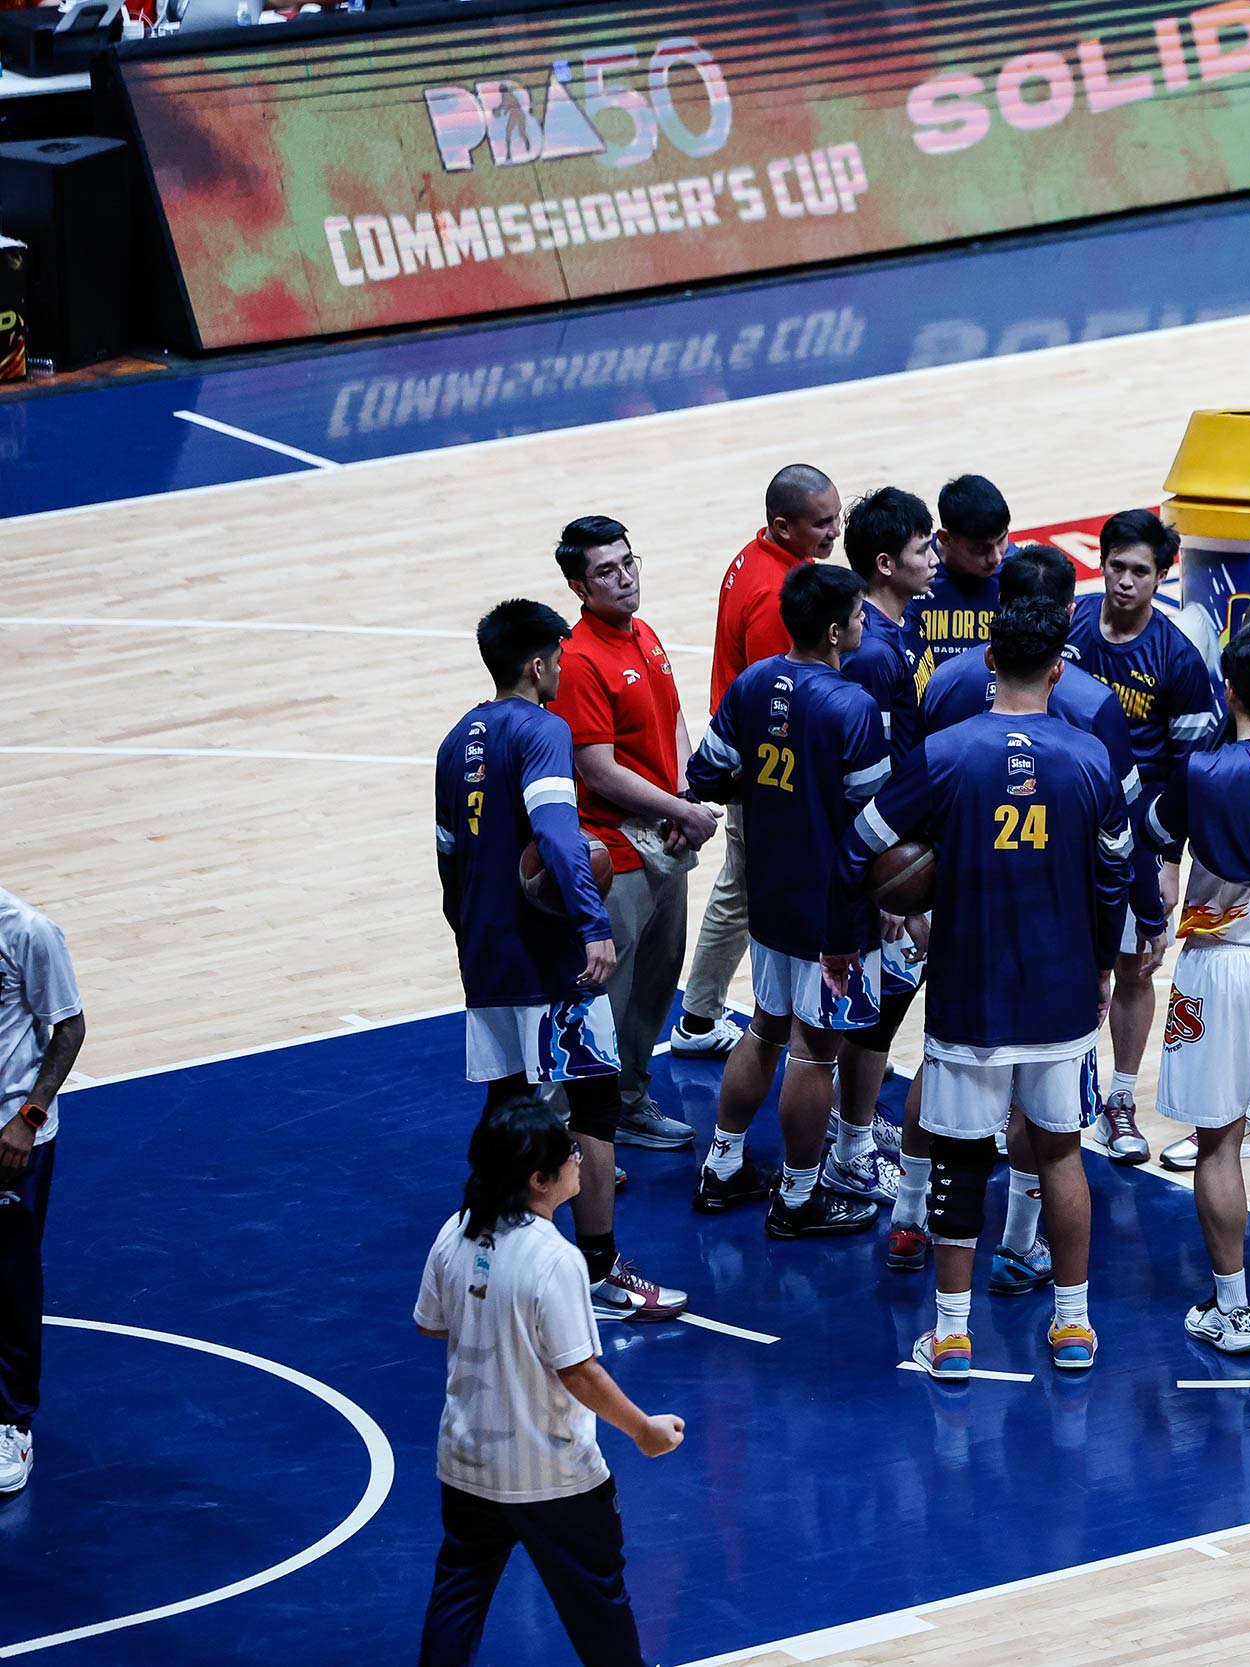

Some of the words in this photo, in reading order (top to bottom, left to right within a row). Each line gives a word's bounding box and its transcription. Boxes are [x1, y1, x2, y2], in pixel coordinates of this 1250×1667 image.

[324, 165, 768, 287] COMMISSIONER'S
[767, 141, 869, 218] CUP
[952, 610, 975, 639] OR
[757, 743, 795, 793] 22
[1011, 758, 1032, 769] Sista
[467, 791, 485, 836] 3
[994, 804, 1049, 850] 24
